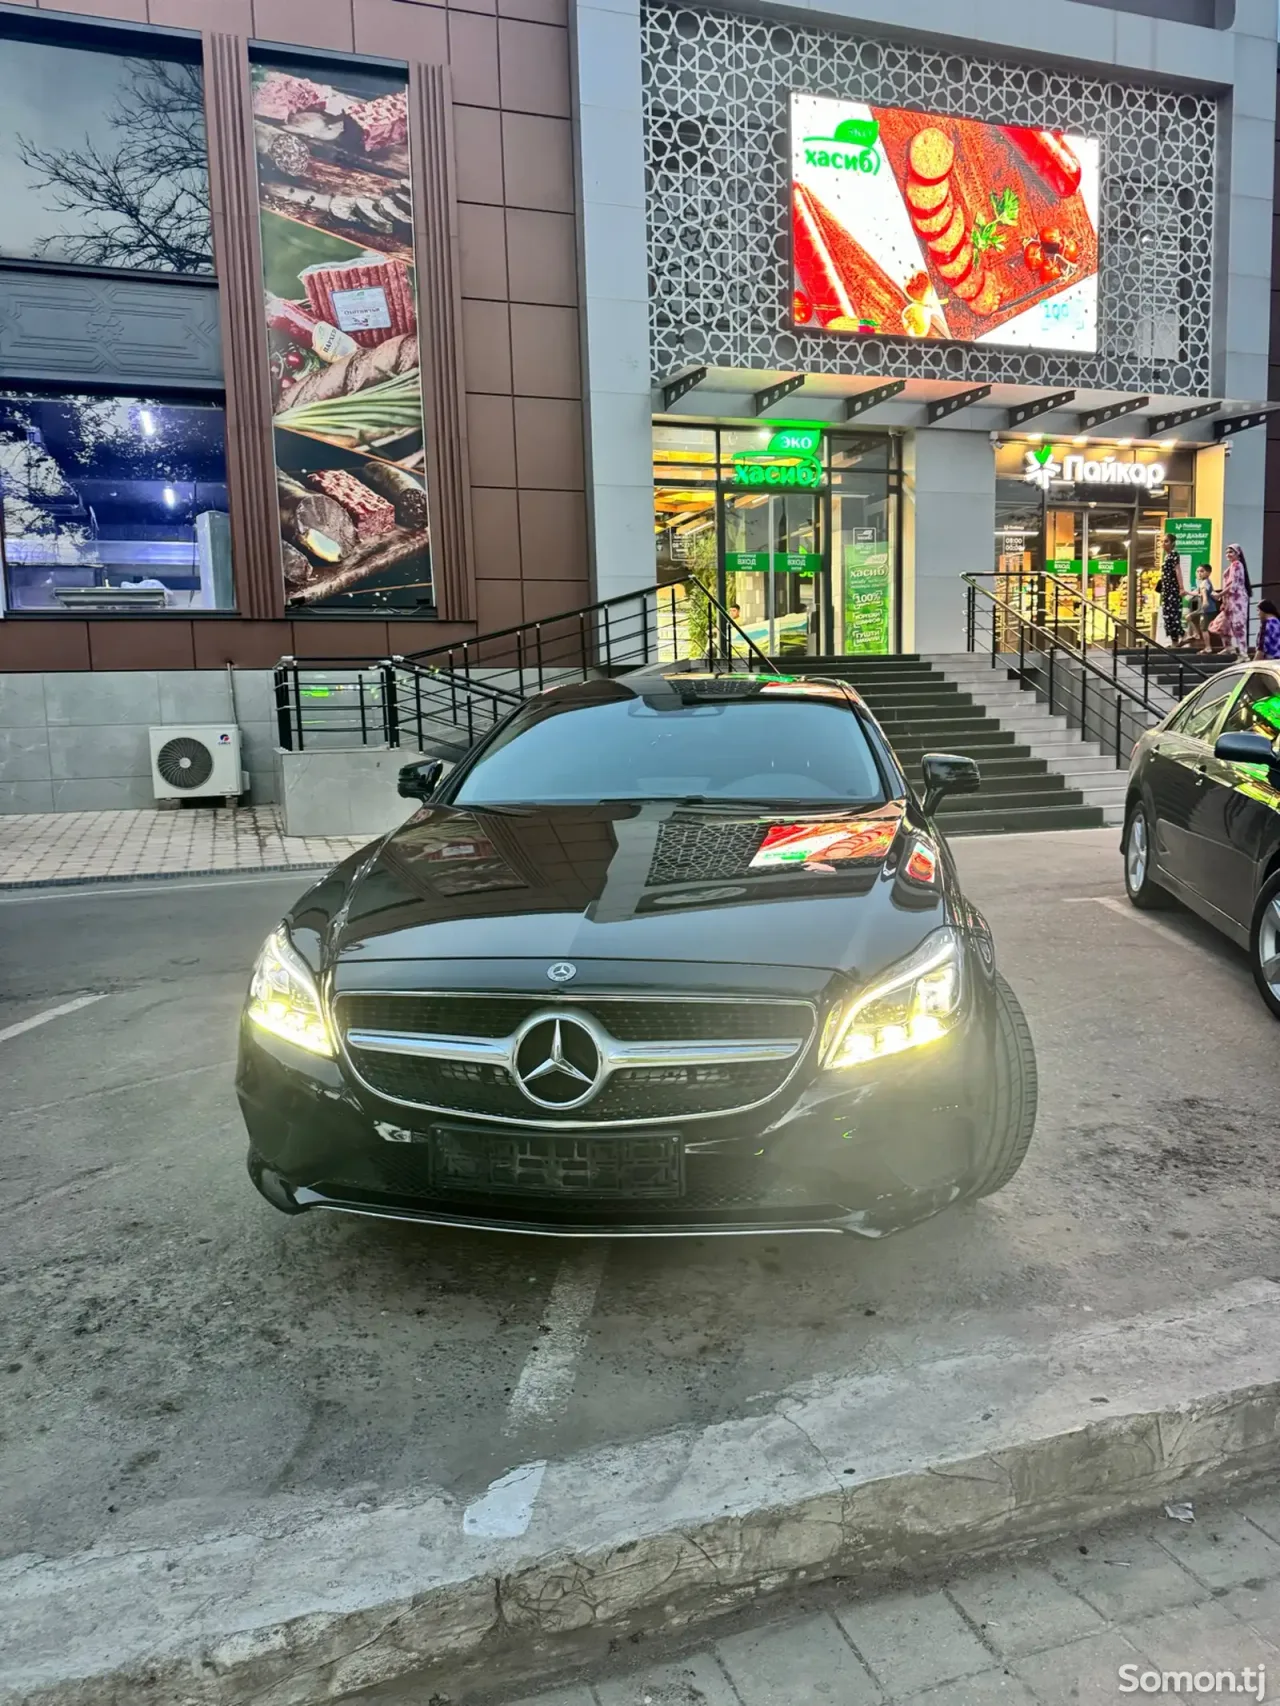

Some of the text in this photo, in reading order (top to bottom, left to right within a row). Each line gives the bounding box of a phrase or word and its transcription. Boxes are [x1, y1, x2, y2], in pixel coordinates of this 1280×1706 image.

[1062, 455, 1166, 489] Пайкар
[737, 558, 757, 566] ВХОД
[787, 559, 807, 567] ВХОД
